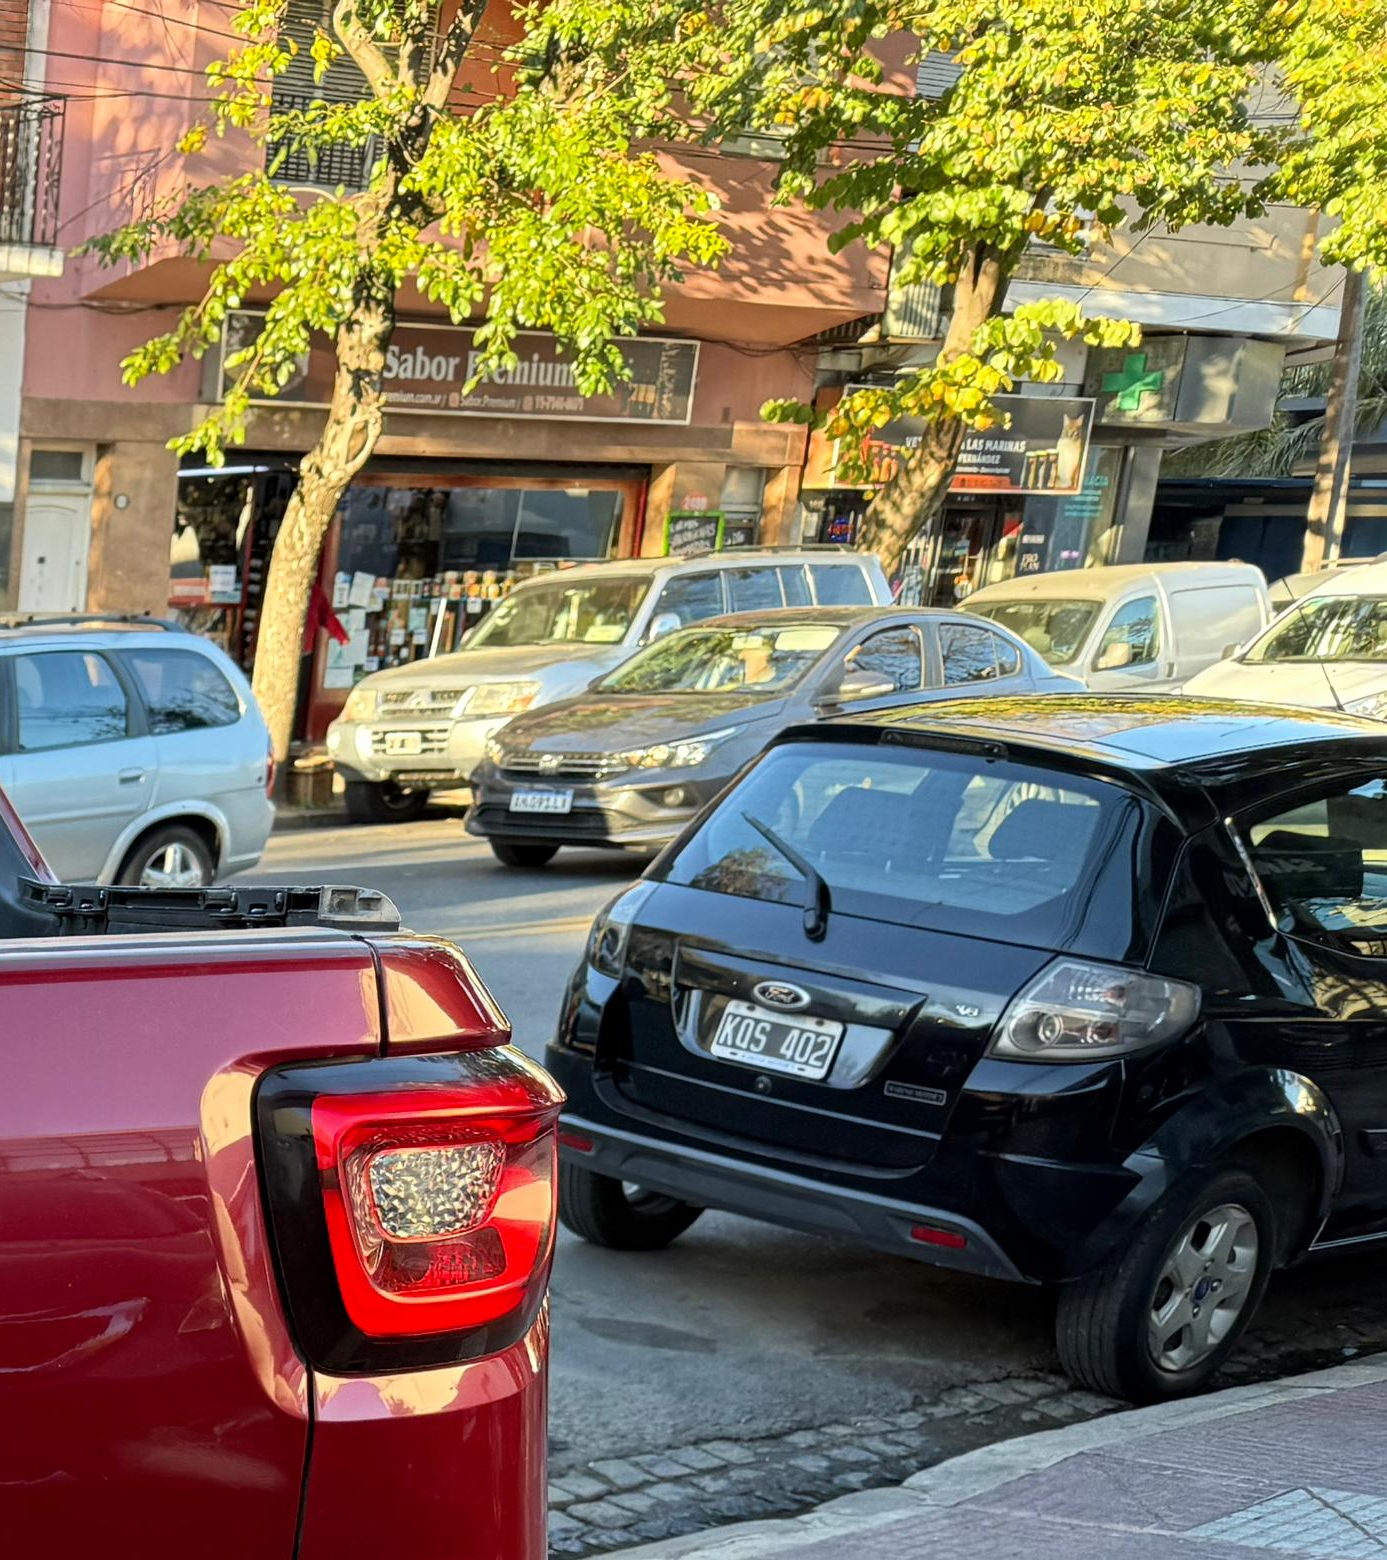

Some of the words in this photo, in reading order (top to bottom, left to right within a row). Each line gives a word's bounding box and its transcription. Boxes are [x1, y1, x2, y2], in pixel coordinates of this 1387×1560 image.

[382, 344, 460, 382] Sabor
[718, 1013, 772, 1053] KQS
[778, 1027, 833, 1068] 402
